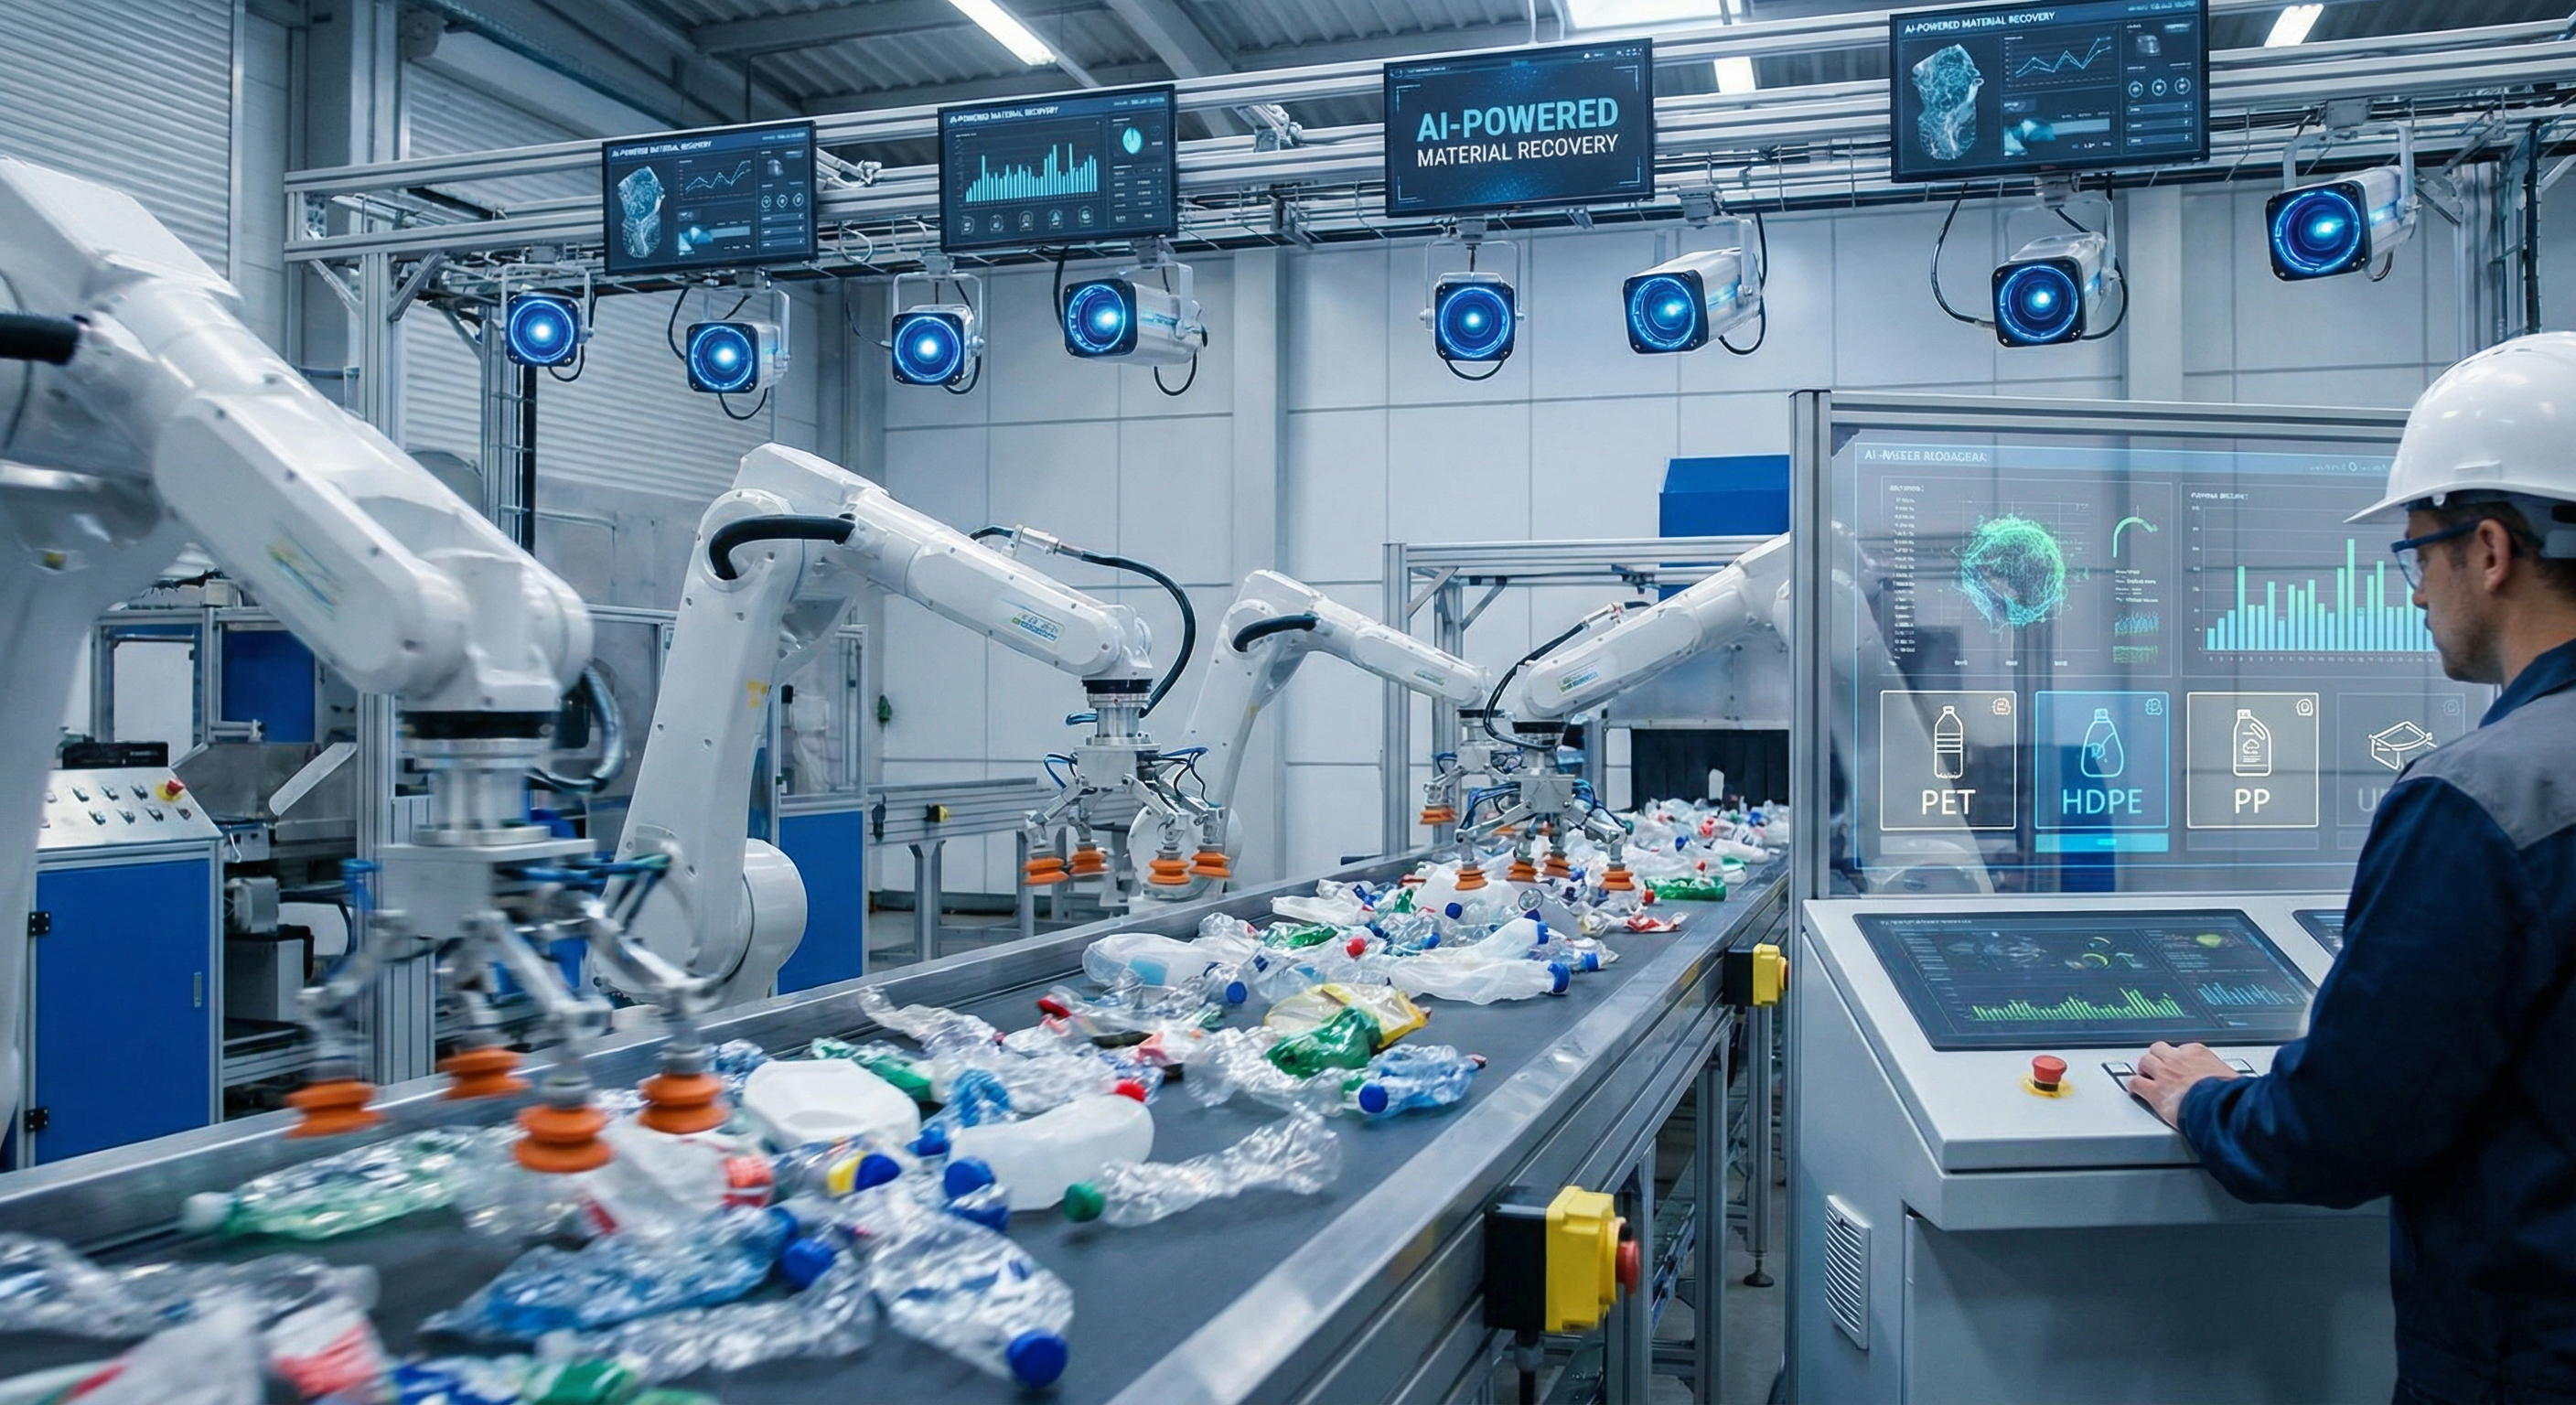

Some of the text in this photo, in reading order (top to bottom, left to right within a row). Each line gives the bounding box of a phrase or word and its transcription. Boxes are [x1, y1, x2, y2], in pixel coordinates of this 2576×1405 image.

[1417, 97, 1619, 142] AI-POWERED
[1417, 134, 1619, 167] MATERIAL RECOVERY
[1922, 788, 1977, 815] PET
[2062, 788, 2142, 815] HDPE
[2235, 788, 2270, 814] PP
[2357, 788, 2388, 812] U
